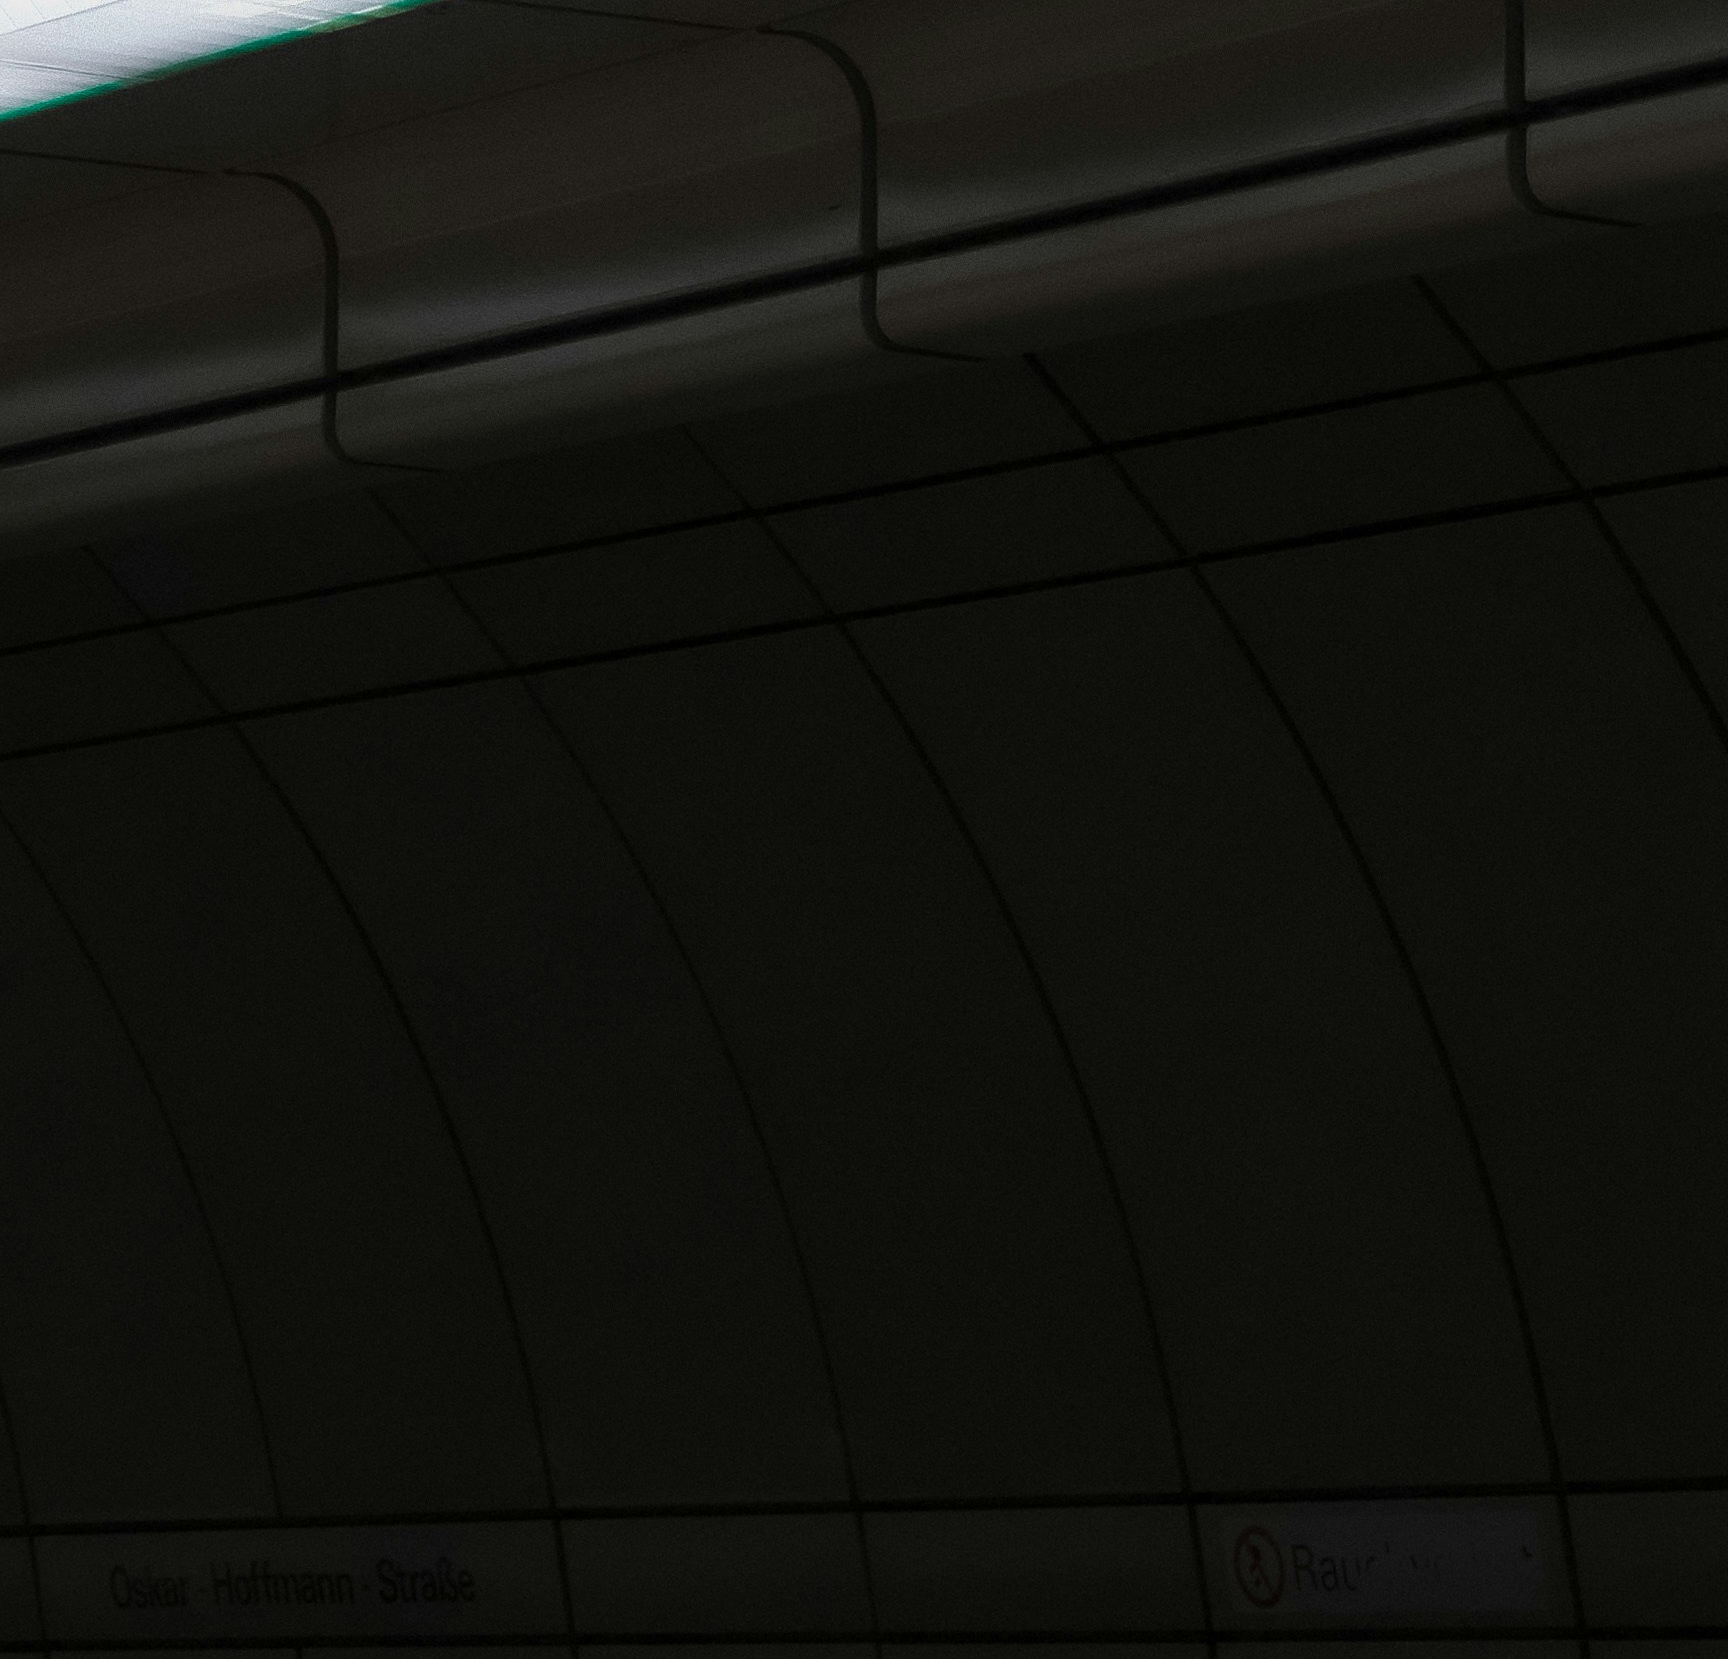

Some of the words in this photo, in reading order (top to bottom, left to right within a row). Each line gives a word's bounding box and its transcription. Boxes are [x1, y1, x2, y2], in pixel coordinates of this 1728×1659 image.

[109, 1564, 189, 1609] Oskar
[210, 1560, 356, 1607] Hoffmann
[376, 1556, 476, 1604] Straße
